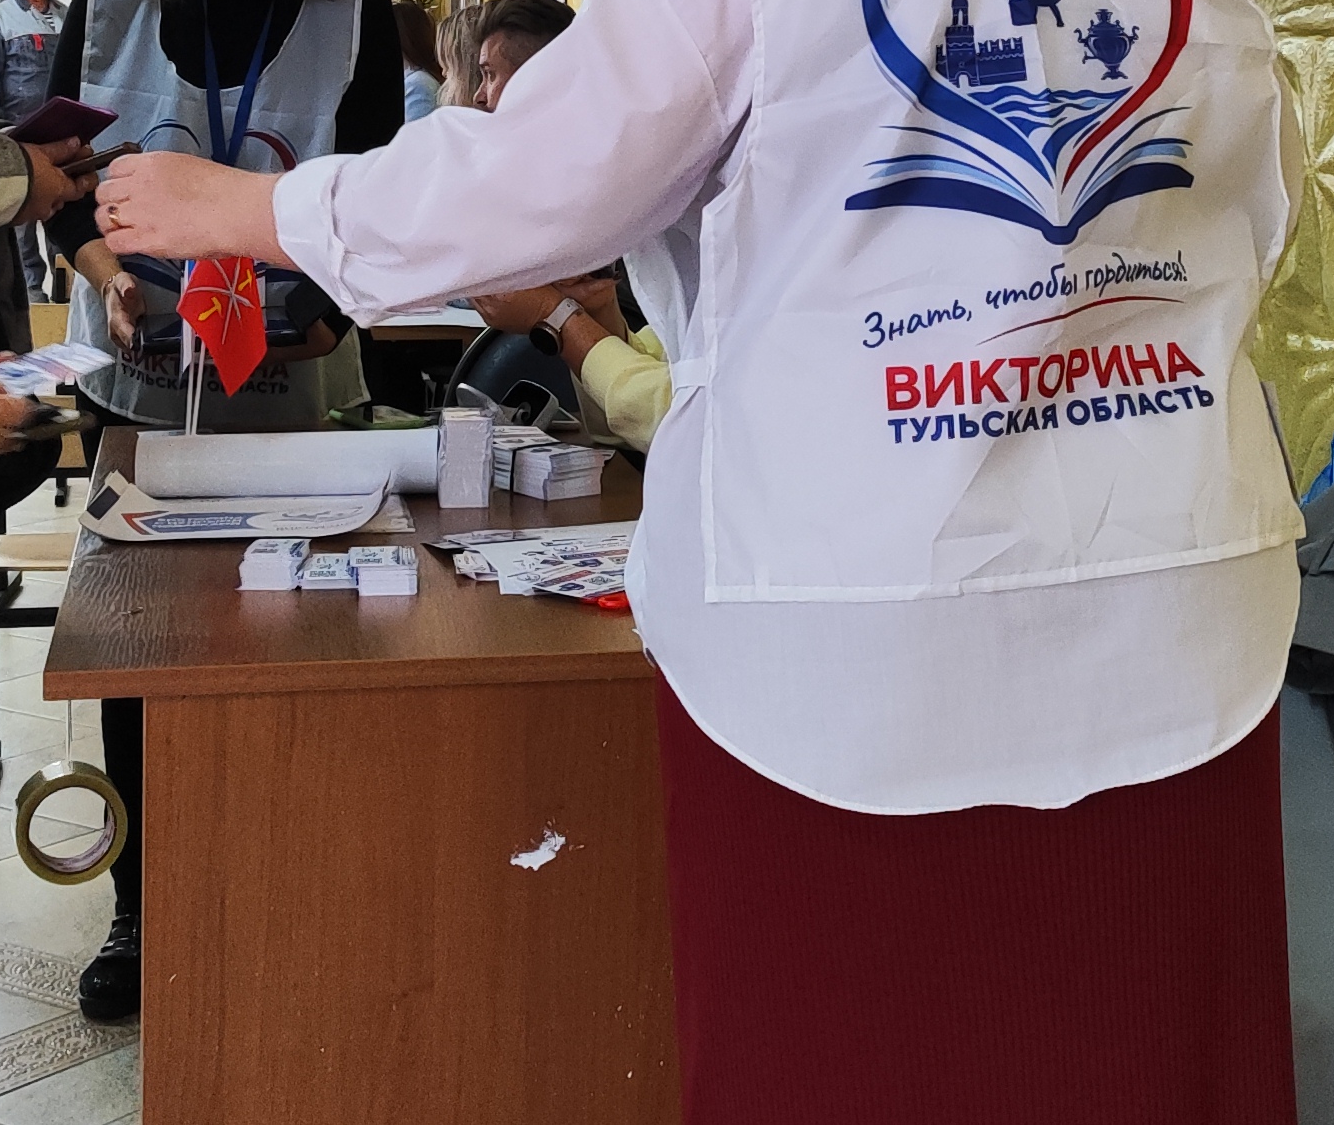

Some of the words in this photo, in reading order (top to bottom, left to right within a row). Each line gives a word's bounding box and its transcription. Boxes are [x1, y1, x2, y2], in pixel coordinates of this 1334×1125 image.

[862, 299, 972, 349] Знать,
[985, 263, 1078, 309] чтобы
[1085, 250, 1187, 297] гордиться!
[885, 342, 1206, 411] ВИКТОРИНА
[887, 403, 1059, 444] ТУЛЬСКАЯ
[1066, 385, 1215, 426] ОБЛАСТЬ
